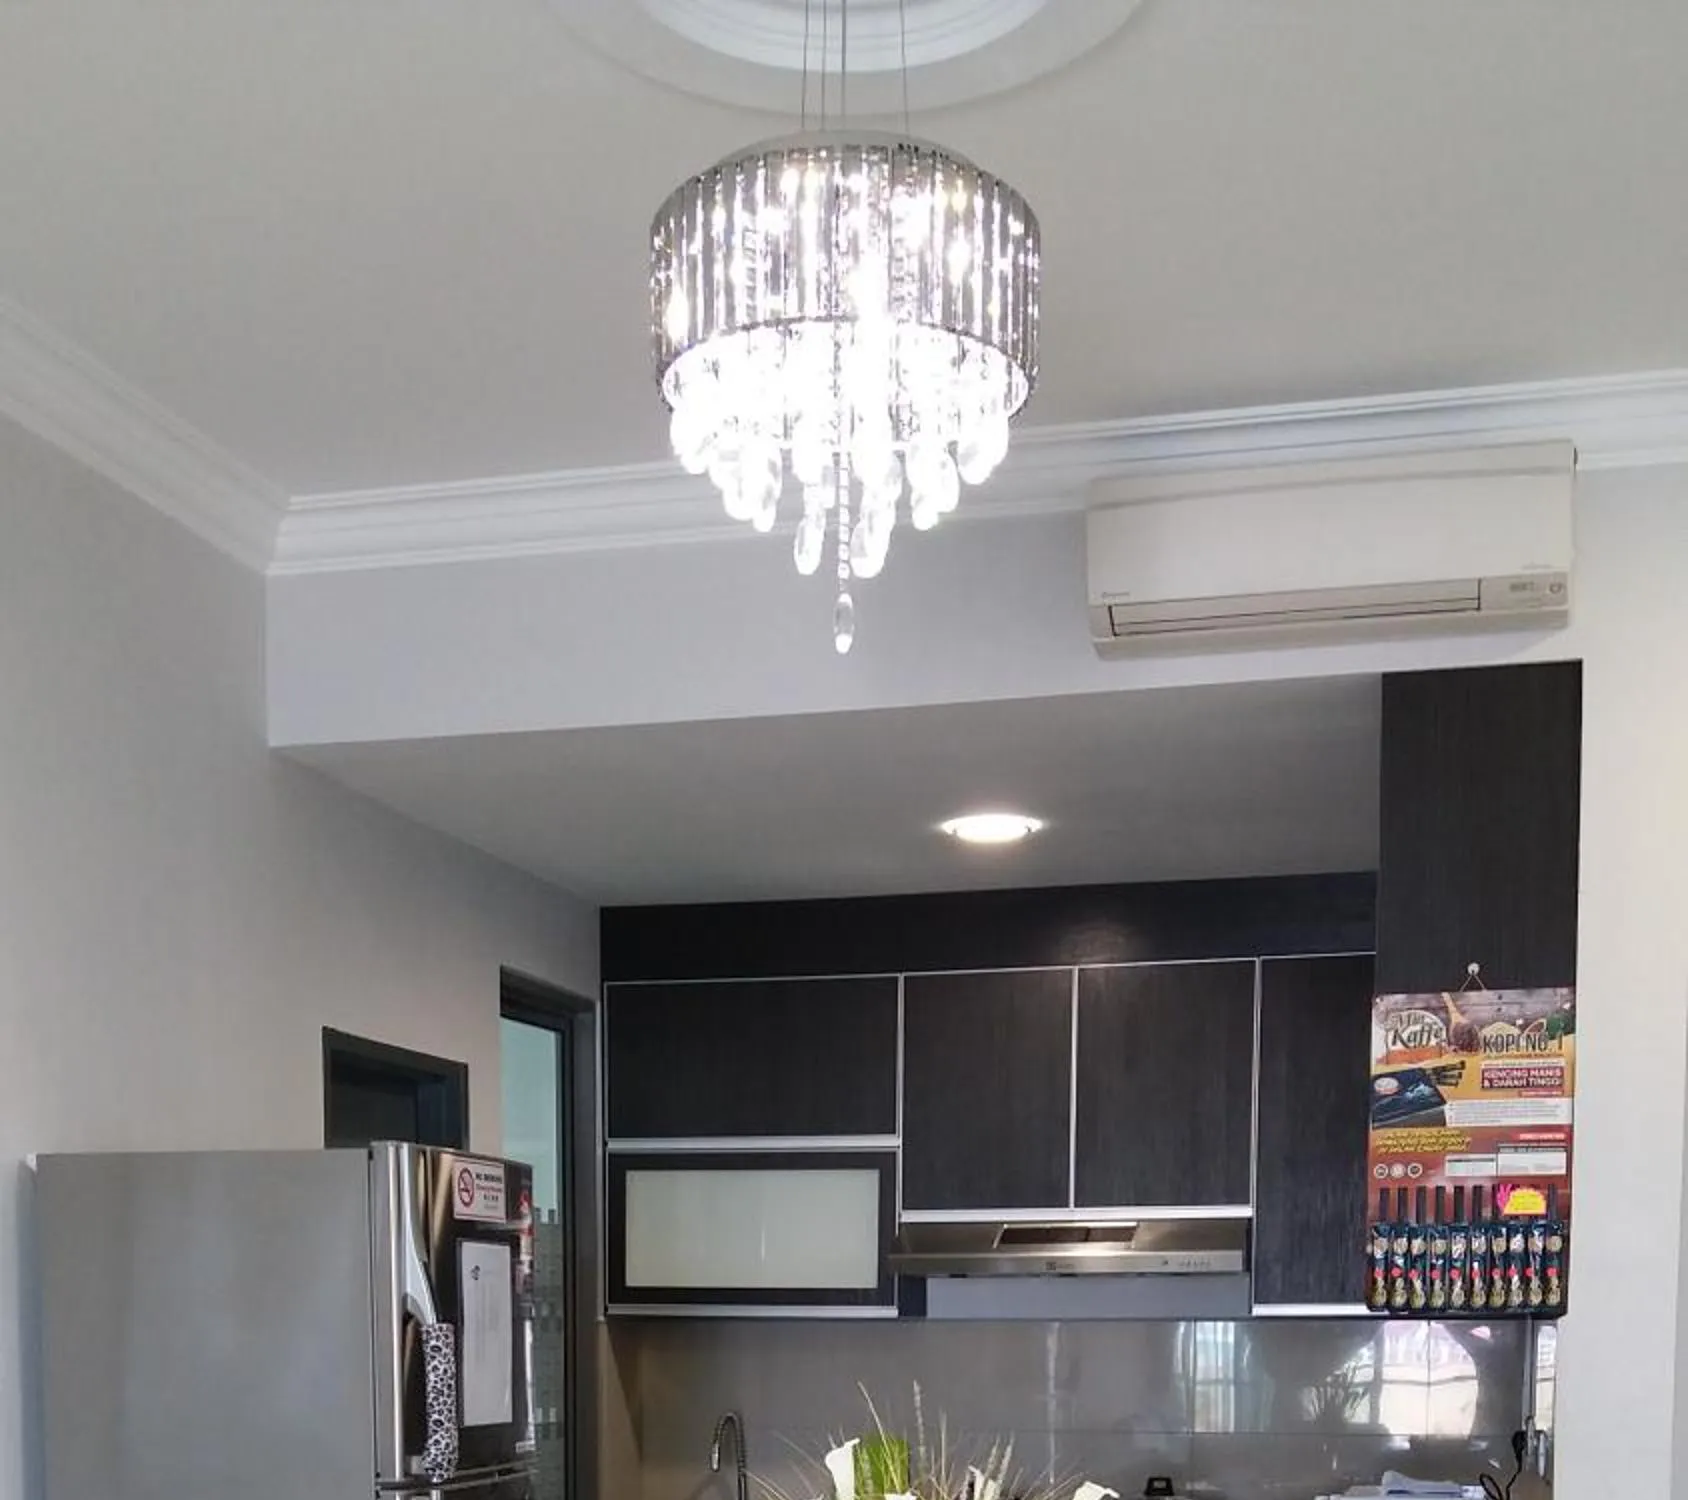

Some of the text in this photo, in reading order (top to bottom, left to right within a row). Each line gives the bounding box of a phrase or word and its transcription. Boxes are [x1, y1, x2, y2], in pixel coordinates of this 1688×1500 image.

[1391, 1022, 1445, 1049] Kaffe
[1483, 1033, 1521, 1053] KOPI
[1530, 1067, 1562, 1078] MANIS
